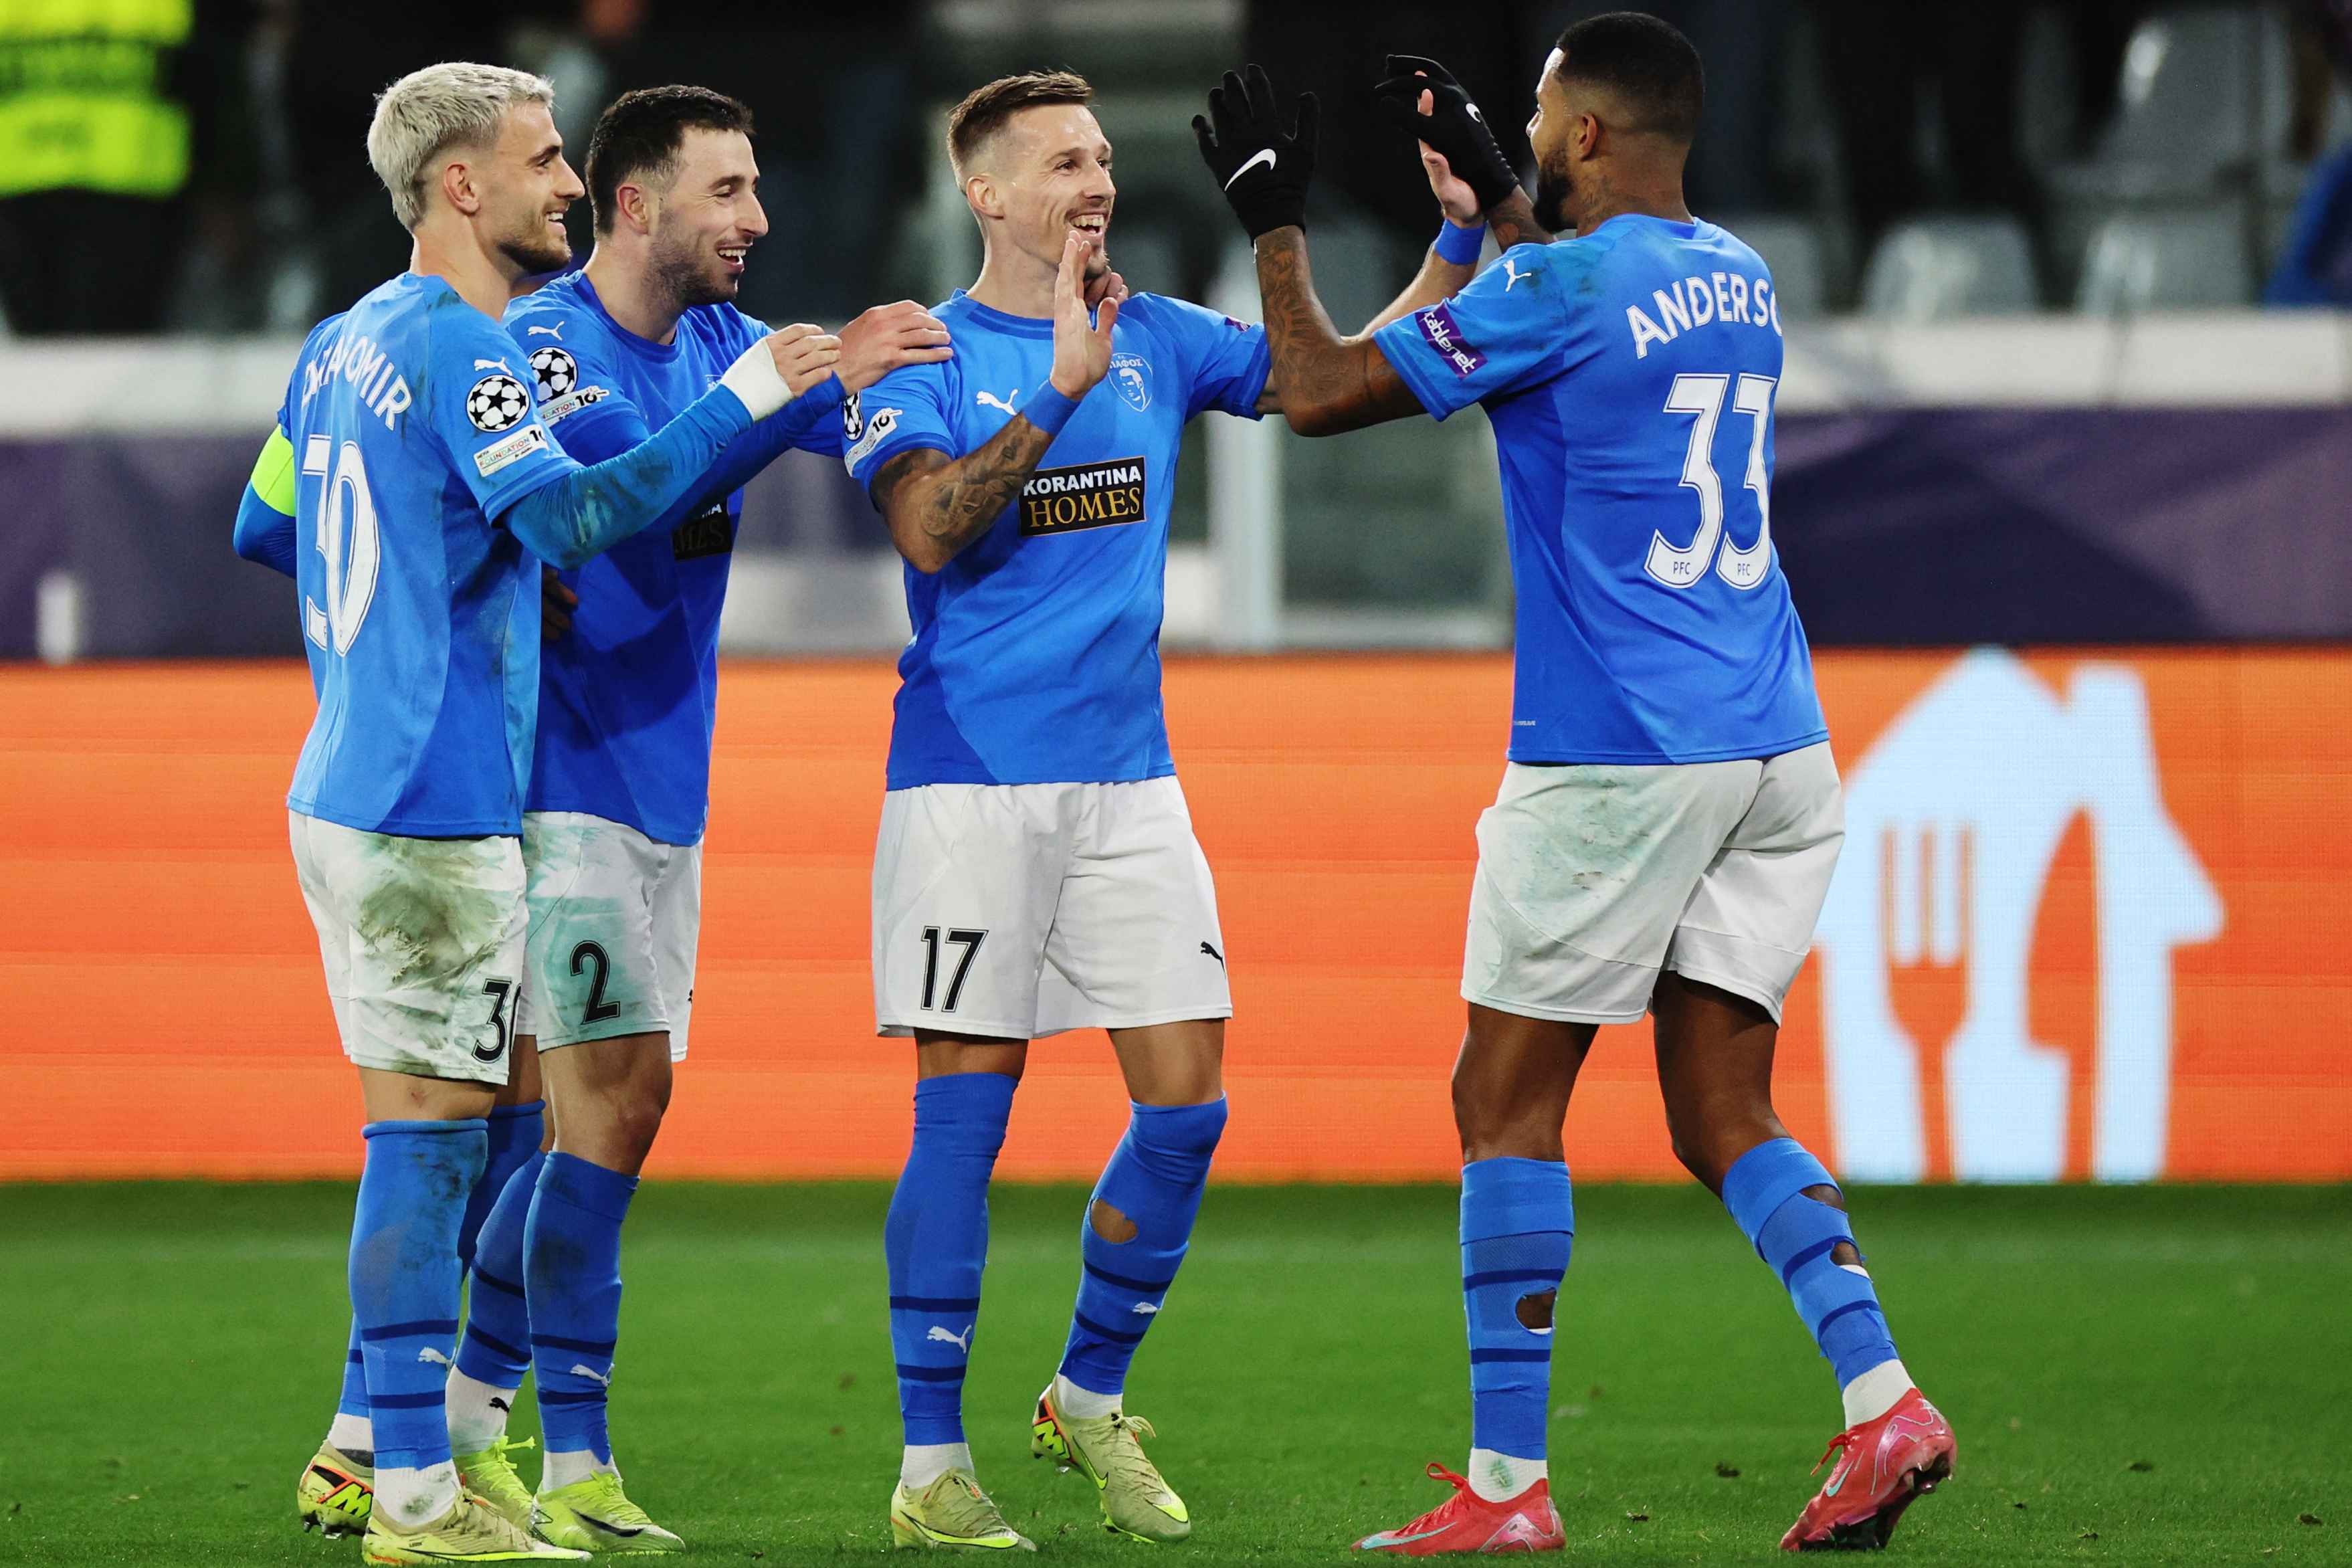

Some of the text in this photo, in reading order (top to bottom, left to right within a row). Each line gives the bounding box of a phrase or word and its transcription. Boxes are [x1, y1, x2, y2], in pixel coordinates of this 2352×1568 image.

[1023, 466, 1142, 496] KORANTINA
[1027, 487, 1140, 528] HOMES
[1644, 372, 1777, 590] 33
[1673, 561, 1690, 575] PFC
[1737, 563, 1751, 576] PFC
[569, 940, 620, 1025] 2
[920, 925, 989, 1013] 17
[471, 978, 522, 1064] 3
